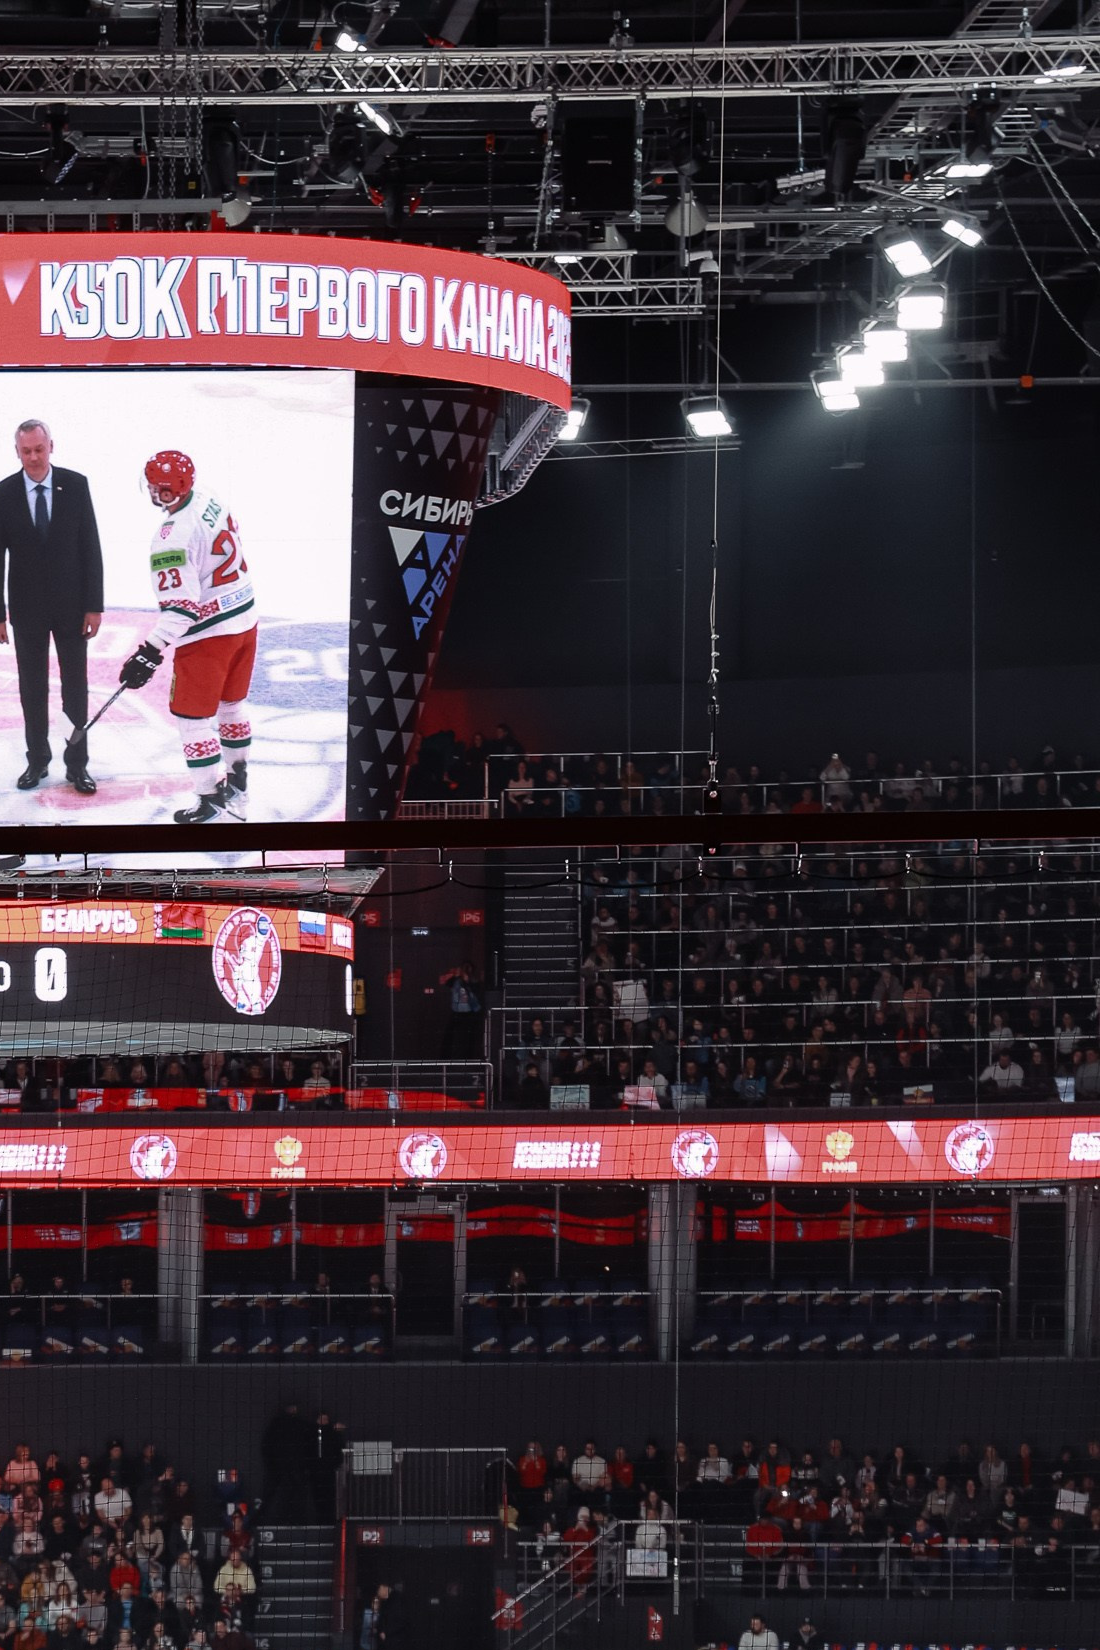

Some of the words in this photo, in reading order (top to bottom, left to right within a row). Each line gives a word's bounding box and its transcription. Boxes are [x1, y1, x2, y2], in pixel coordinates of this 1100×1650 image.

[433, 276, 547, 371] КАНАЛА
[379, 489, 474, 526] СИБИРЬ
[157, 567, 183, 592] 23
[412, 535, 466, 641] АРЕНА
[40, 908, 138, 935] БЕЛАРУСЬ
[34, 947, 68, 1002] 0
[362, 1531, 381, 1544] P2
